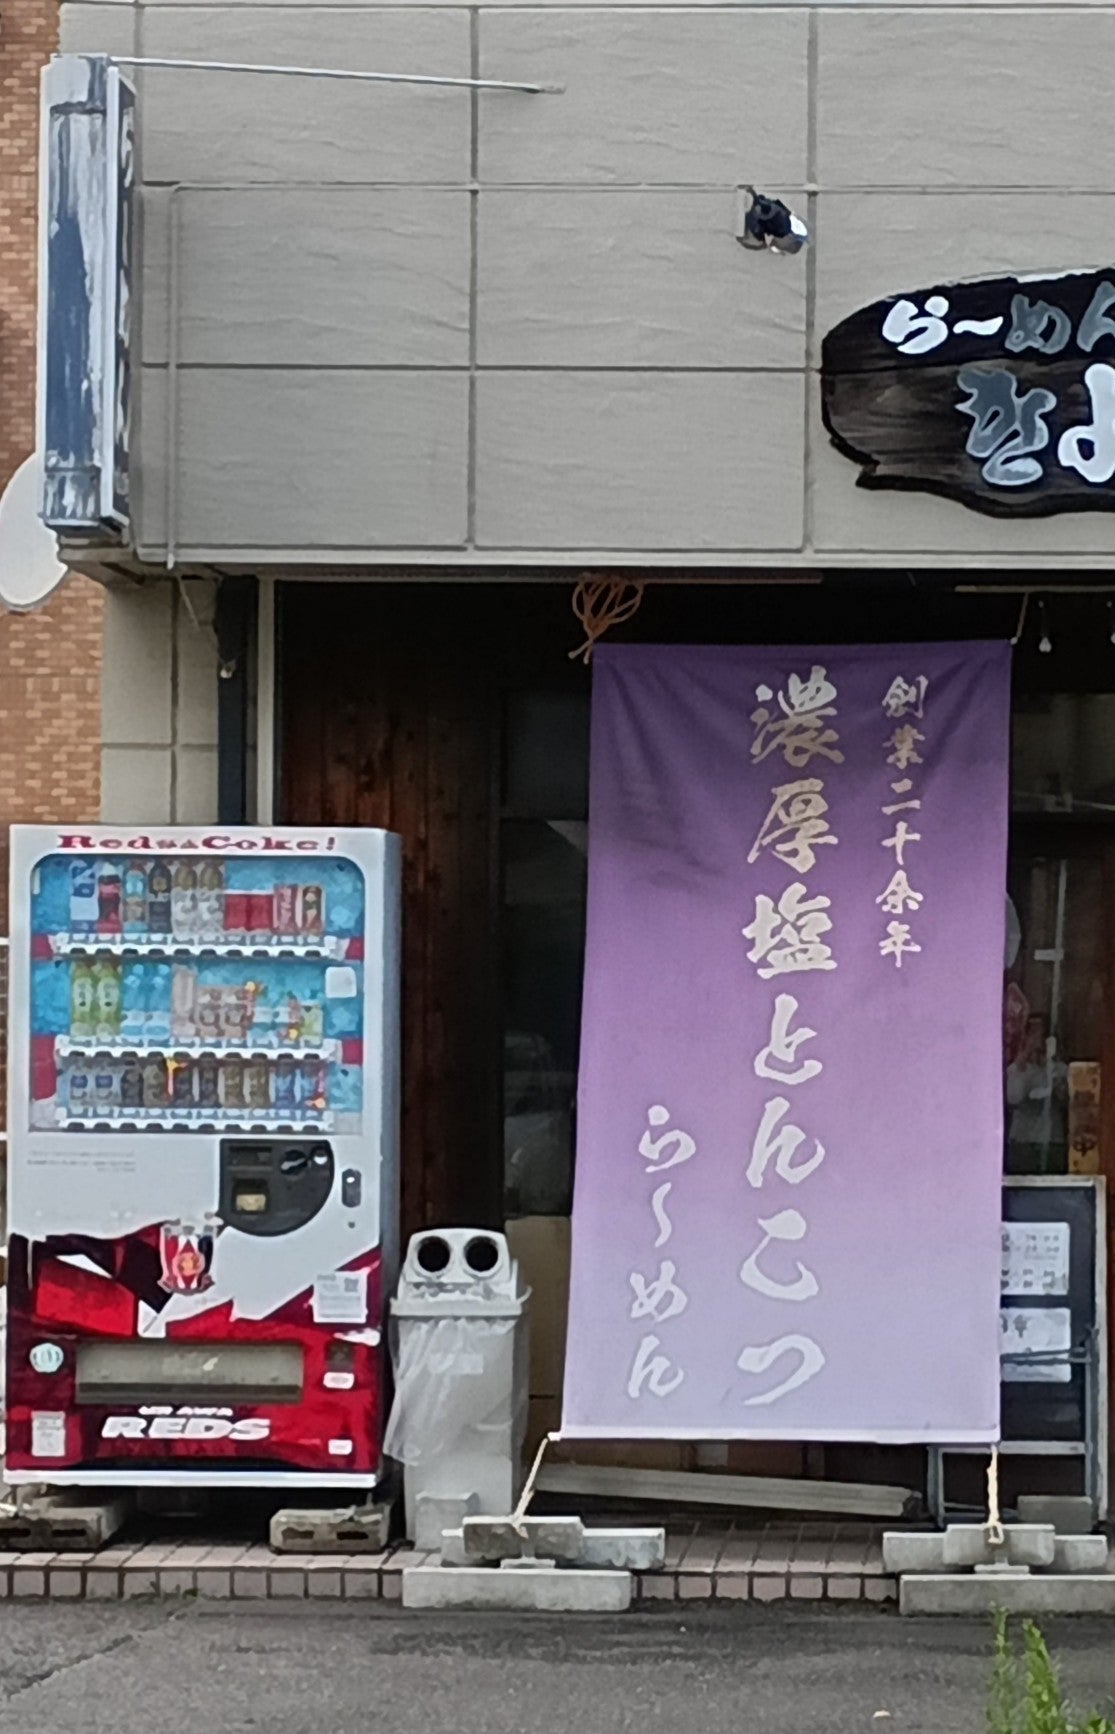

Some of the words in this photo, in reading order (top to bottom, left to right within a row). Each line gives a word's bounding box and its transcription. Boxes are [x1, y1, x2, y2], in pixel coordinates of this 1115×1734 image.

[876, 676, 928, 967] 創業二十余年
[737, 665, 845, 1406] 濃厚塩とんこつ
[101, 1416, 271, 1441] REDS
